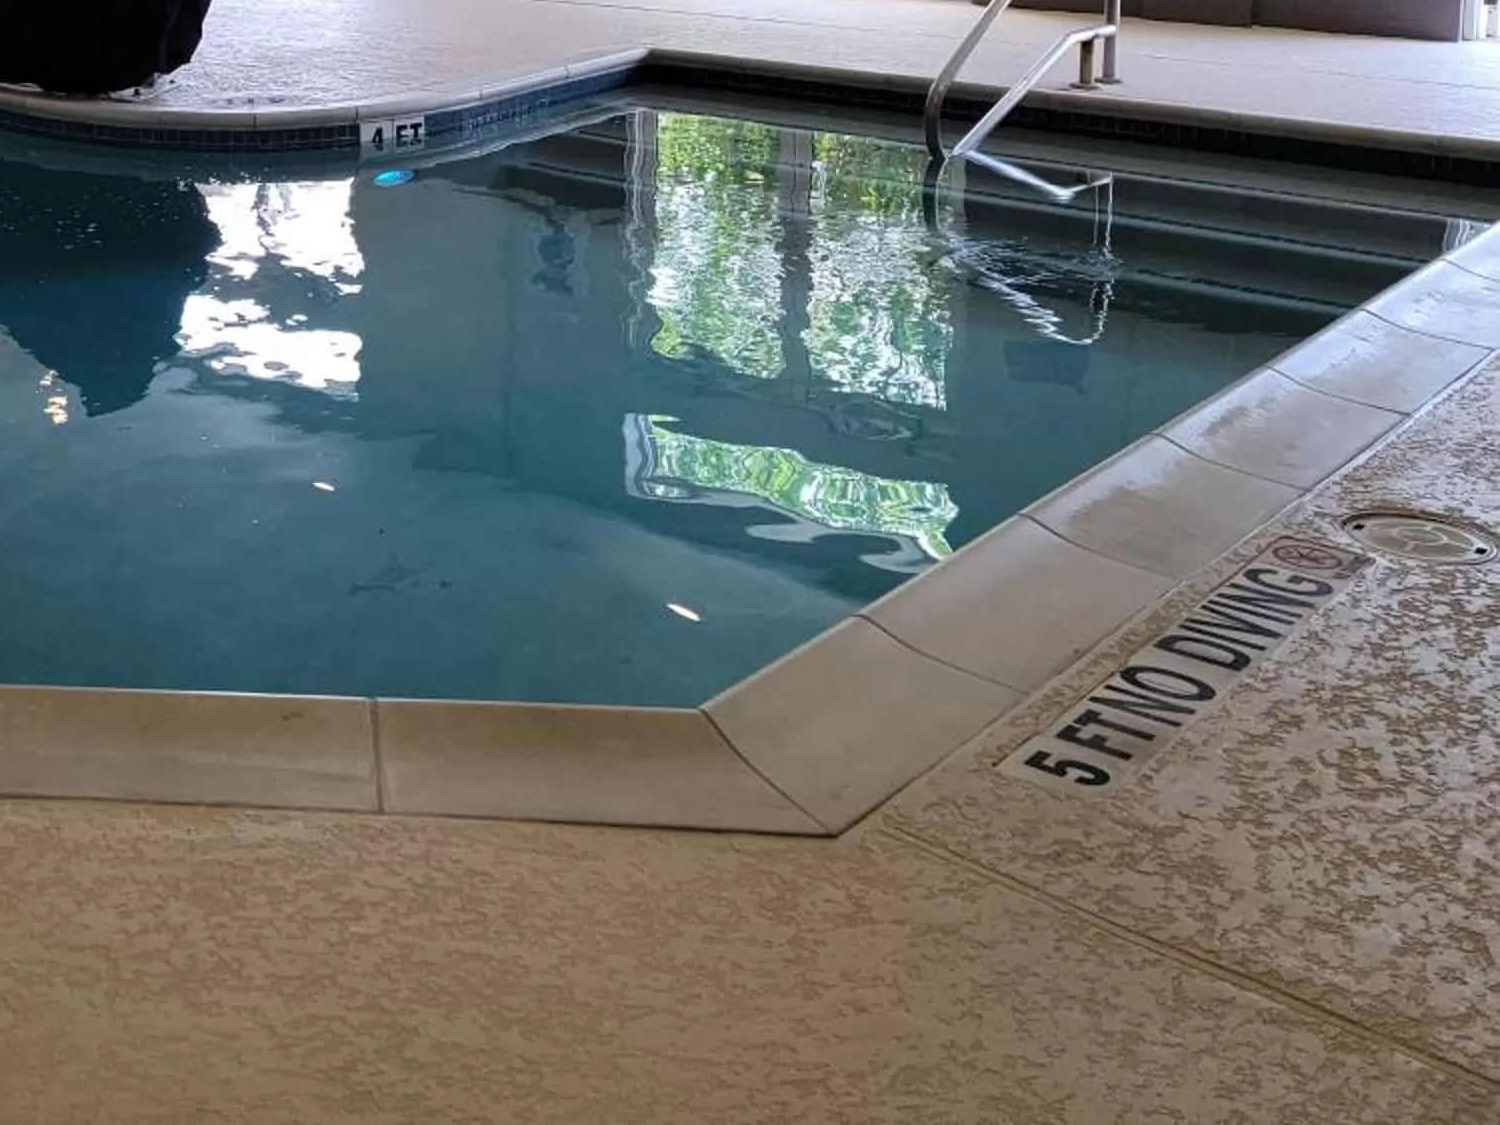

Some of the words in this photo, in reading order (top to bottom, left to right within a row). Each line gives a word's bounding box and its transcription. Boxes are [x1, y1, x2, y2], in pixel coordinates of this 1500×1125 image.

[1153, 567, 1335, 673] DIVING
[1089, 664, 1218, 728] NO
[1055, 708, 1157, 761] FT
[1024, 749, 1112, 787] 5
